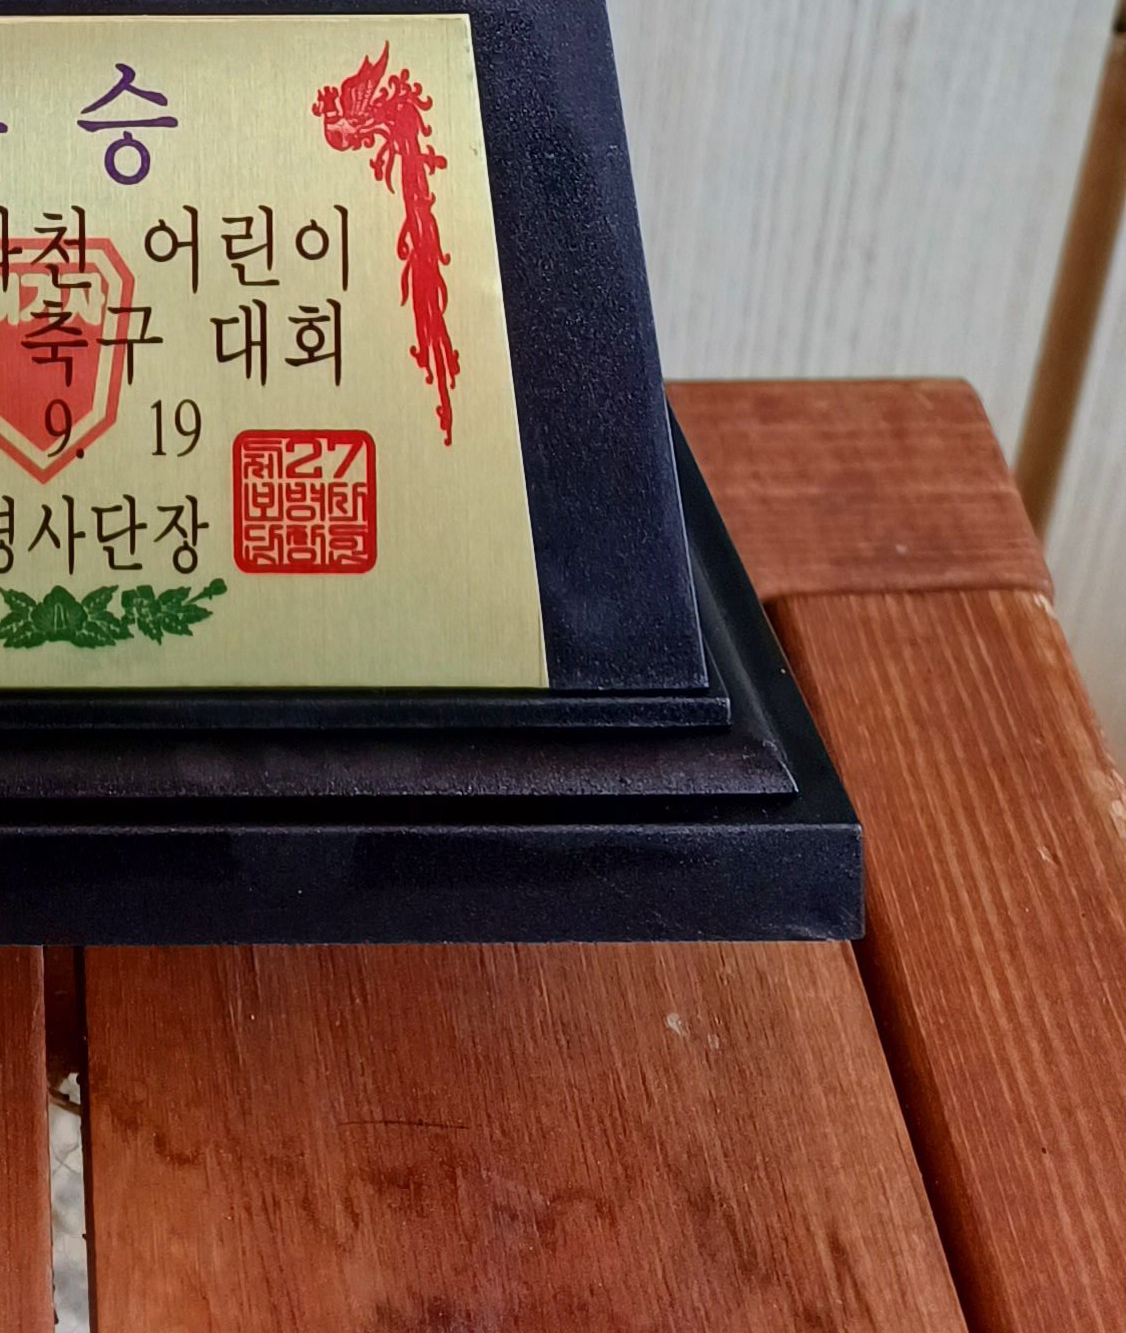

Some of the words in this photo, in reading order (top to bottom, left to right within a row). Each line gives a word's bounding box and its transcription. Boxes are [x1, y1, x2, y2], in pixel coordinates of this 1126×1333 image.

[144, 204, 350, 293] 어린이
[21, 299, 164, 388] 축구
[209, 298, 342, 387] 대회
[44, 398, 85, 459] 9.
[150, 398, 202, 458] 19
